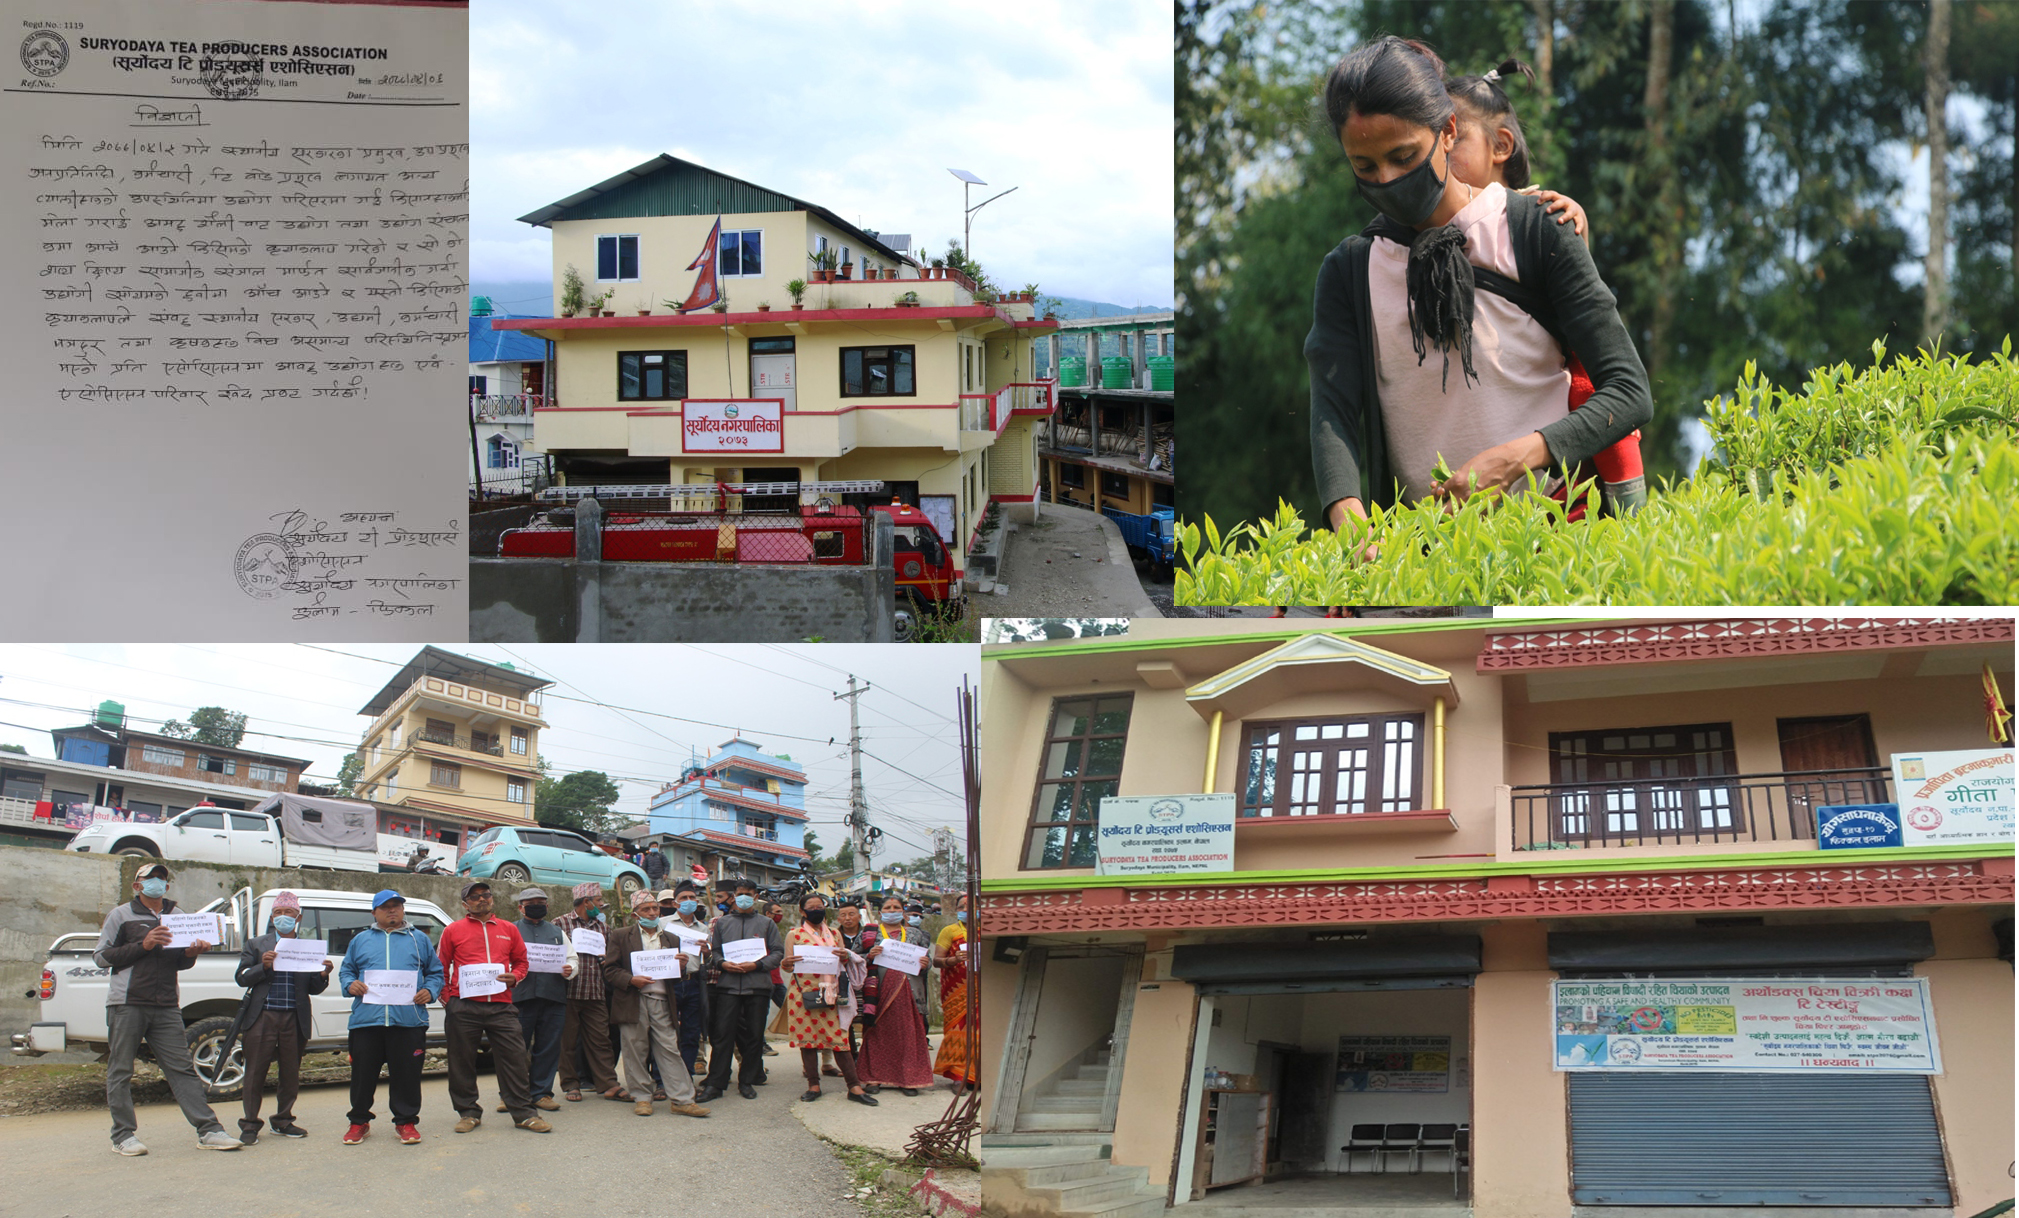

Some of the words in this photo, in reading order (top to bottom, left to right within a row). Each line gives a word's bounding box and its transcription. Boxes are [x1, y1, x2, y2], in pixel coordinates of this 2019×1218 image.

[80, 38, 165, 52] SURYODAYA
[170, 42, 197, 53] TEA
[203, 43, 287, 55] PRODUCERS
[292, 45, 387, 59] ASSOCIATION
[178, 56, 194, 70] टि
[270, 58, 355, 76] एशोसिएसन)
[279, 79, 297, 87] Ilam
[348, 91, 366, 99] Date
[686, 415, 720, 436] सूर्योदय
[721, 415, 780, 432] नगरपालिका
[719, 436, 748, 446] २०७३
[1914, 771, 1955, 799] प्रजापिता
[1944, 784, 1998, 802] गीता
[1101, 824, 1132, 837] सूर्योदय
[1134, 824, 1143, 834] टि
[1188, 853, 1228, 861] ASSOCIATION
[1809, 985, 1840, 997] चिया
[1885, 988, 1913, 998] कक्ष
[1684, 997, 1730, 1005] COMMUNITY
[1797, 999, 1811, 1010] टि
[1813, 1059, 1860, 1067] धन्यवाद
